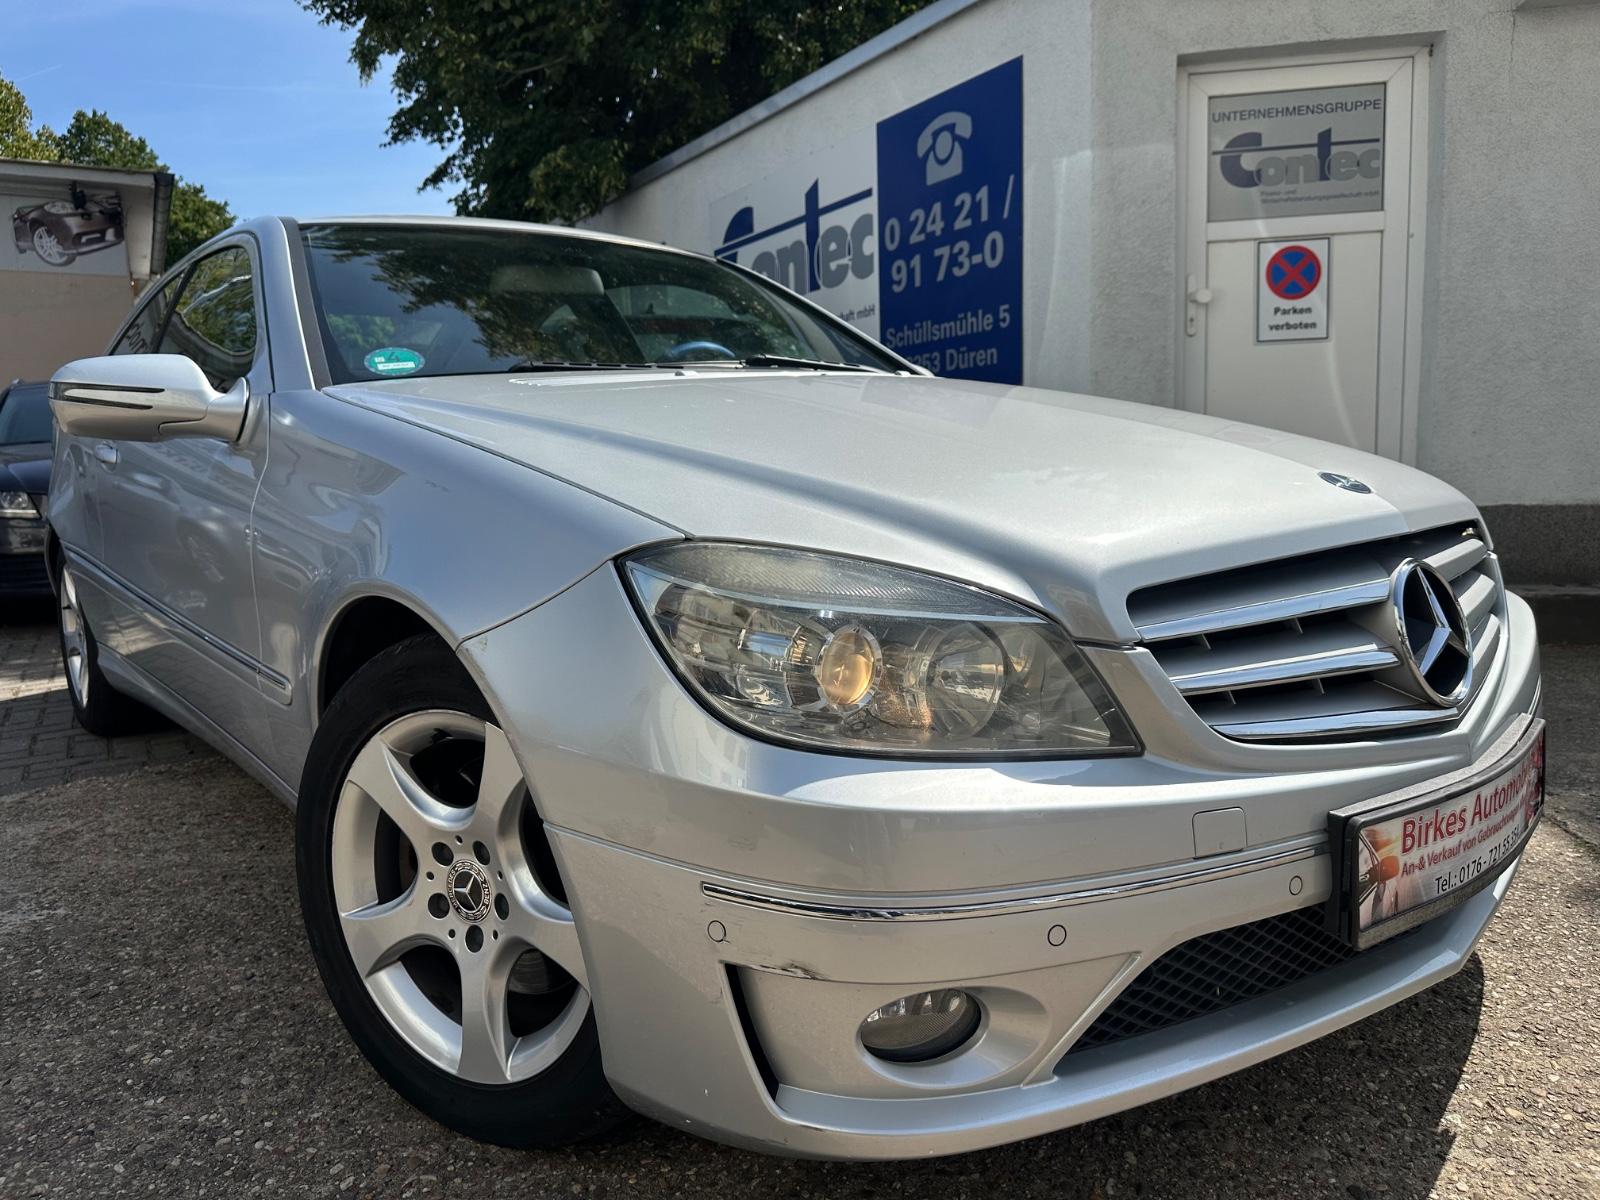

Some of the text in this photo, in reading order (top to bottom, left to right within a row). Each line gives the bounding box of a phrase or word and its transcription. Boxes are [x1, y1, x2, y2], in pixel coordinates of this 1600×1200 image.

[1212, 99, 1382, 123] UNTERNEHMENSGRUPPE
[1217, 128, 1380, 188] Contec
[884, 174, 1015, 251] 0 24 21 /
[891, 230, 1005, 292] 91 73-0
[886, 303, 1011, 349] Schüllsmühle 5
[1268, 321, 1317, 331] verboten
[1273, 305, 1312, 316] Parken
[945, 346, 998, 372] Düren
[1401, 806, 1467, 854] Birkes
[1427, 842, 1461, 867] Verkauf
[1462, 837, 1477, 853] von
[1435, 871, 1457, 894] Tel.:
[1460, 856, 1482, 883] 0176
[1488, 844, 1501, 866] 721
